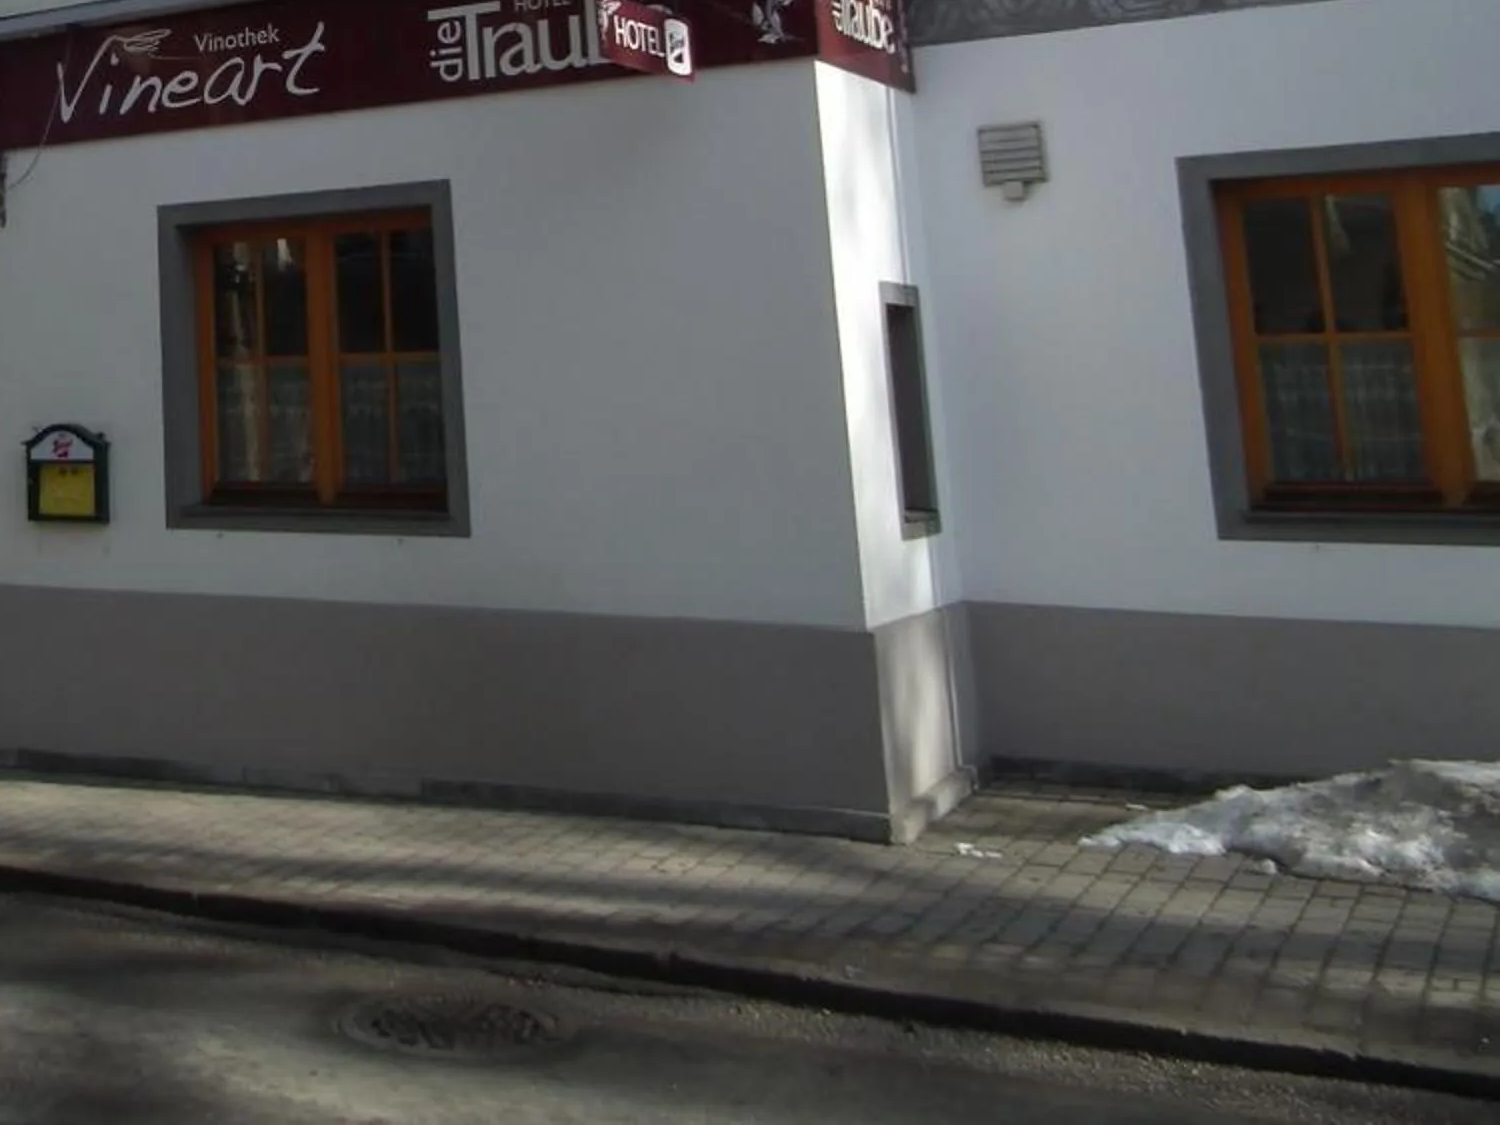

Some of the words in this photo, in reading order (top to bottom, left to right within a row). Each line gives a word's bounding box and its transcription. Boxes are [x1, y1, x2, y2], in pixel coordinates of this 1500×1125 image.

[193, 23, 282, 53] Vinothek
[430, 20, 464, 83] die
[612, 14, 666, 58] HOTEL
[56, 21, 326, 124] Vineart
